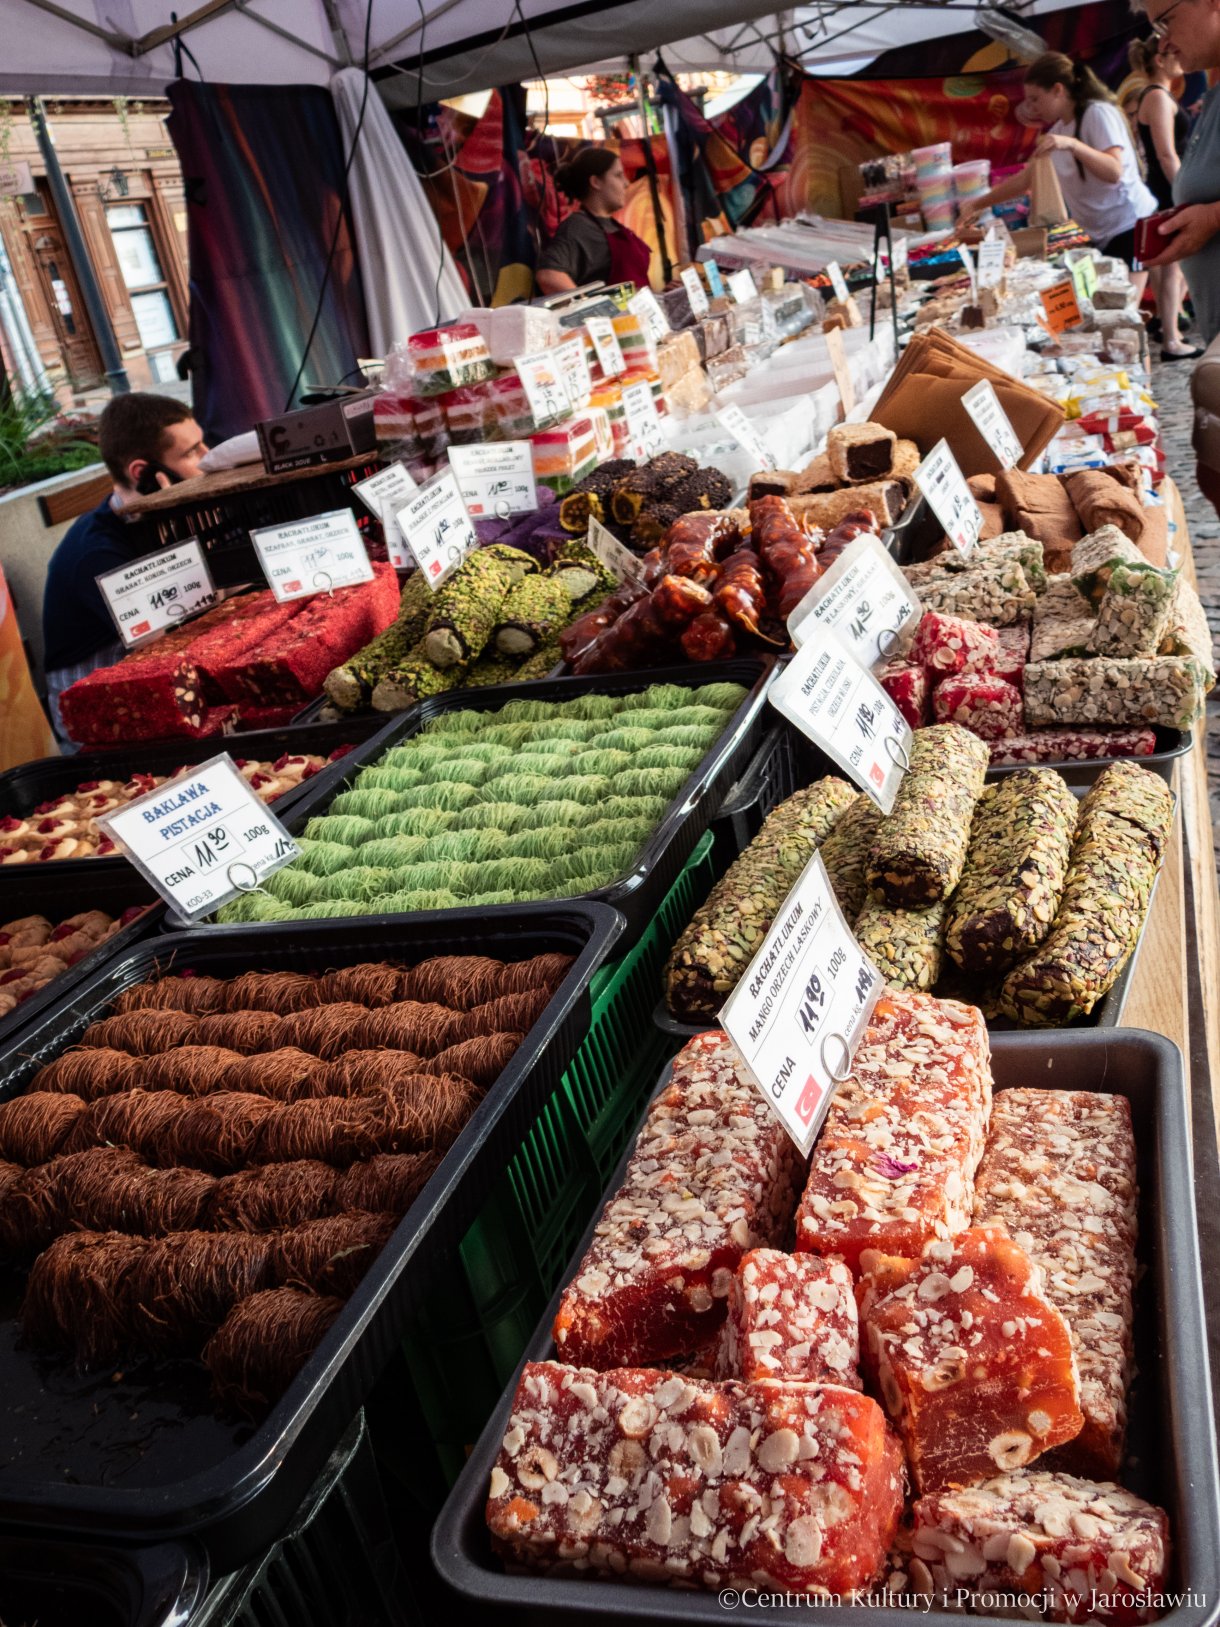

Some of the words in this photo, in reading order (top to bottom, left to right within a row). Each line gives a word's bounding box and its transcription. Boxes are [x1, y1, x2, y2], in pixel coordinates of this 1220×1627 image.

[124, 554, 177, 580] RACHATLUKUM
[272, 566, 292, 577] CENA
[336, 552, 354, 560] 100g
[418, 546, 430, 560] CENA
[119, 608, 139, 622] CENA
[184, 581, 202, 592] 100g
[814, 566, 859, 618] RACHATLUKUM
[880, 590, 896, 608] 100g
[801, 651, 832, 696] RACHATLUKUM
[849, 745, 864, 766] CENA
[873, 699, 885, 715] 100g
[142, 782, 210, 824] BAKLAWA
[160, 801, 223, 841] PISTACJA
[164, 866, 195, 887] CENA
[243, 824, 270, 842] 100g
[186, 890, 214, 908] KOD-33
[266, 854, 274, 864] kg
[749, 901, 804, 1000] RACHATLUKUM
[749, 996, 773, 1043] MANGO
[770, 954, 795, 998] ORZECH
[792, 896, 822, 955] LASKOWY
[771, 1056, 796, 1099] CENA
[827, 946, 846, 980] 100g
[844, 1015, 856, 1037] cena
[853, 1004, 863, 1016] kg
